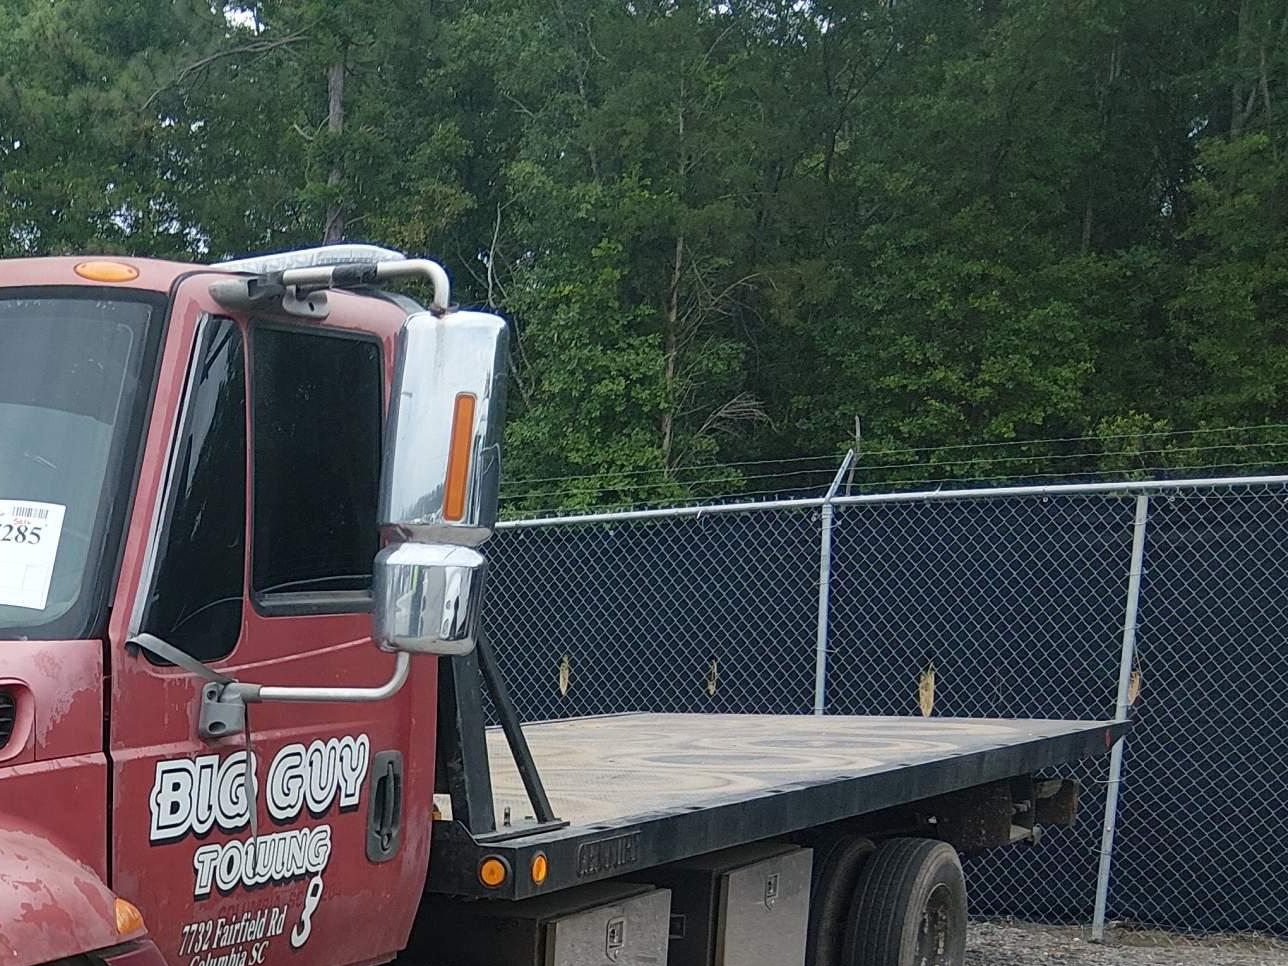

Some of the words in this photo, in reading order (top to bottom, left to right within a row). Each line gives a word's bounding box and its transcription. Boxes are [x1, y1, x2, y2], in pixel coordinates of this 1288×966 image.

[150, 750, 258, 844] BIG
[266, 733, 370, 823] GUY
[193, 825, 332, 899] TOWING
[179, 921, 213, 956] 7732
[212, 908, 268, 950] Fairfield
[266, 904, 288, 937] Rd
[247, 940, 270, 966] SC
